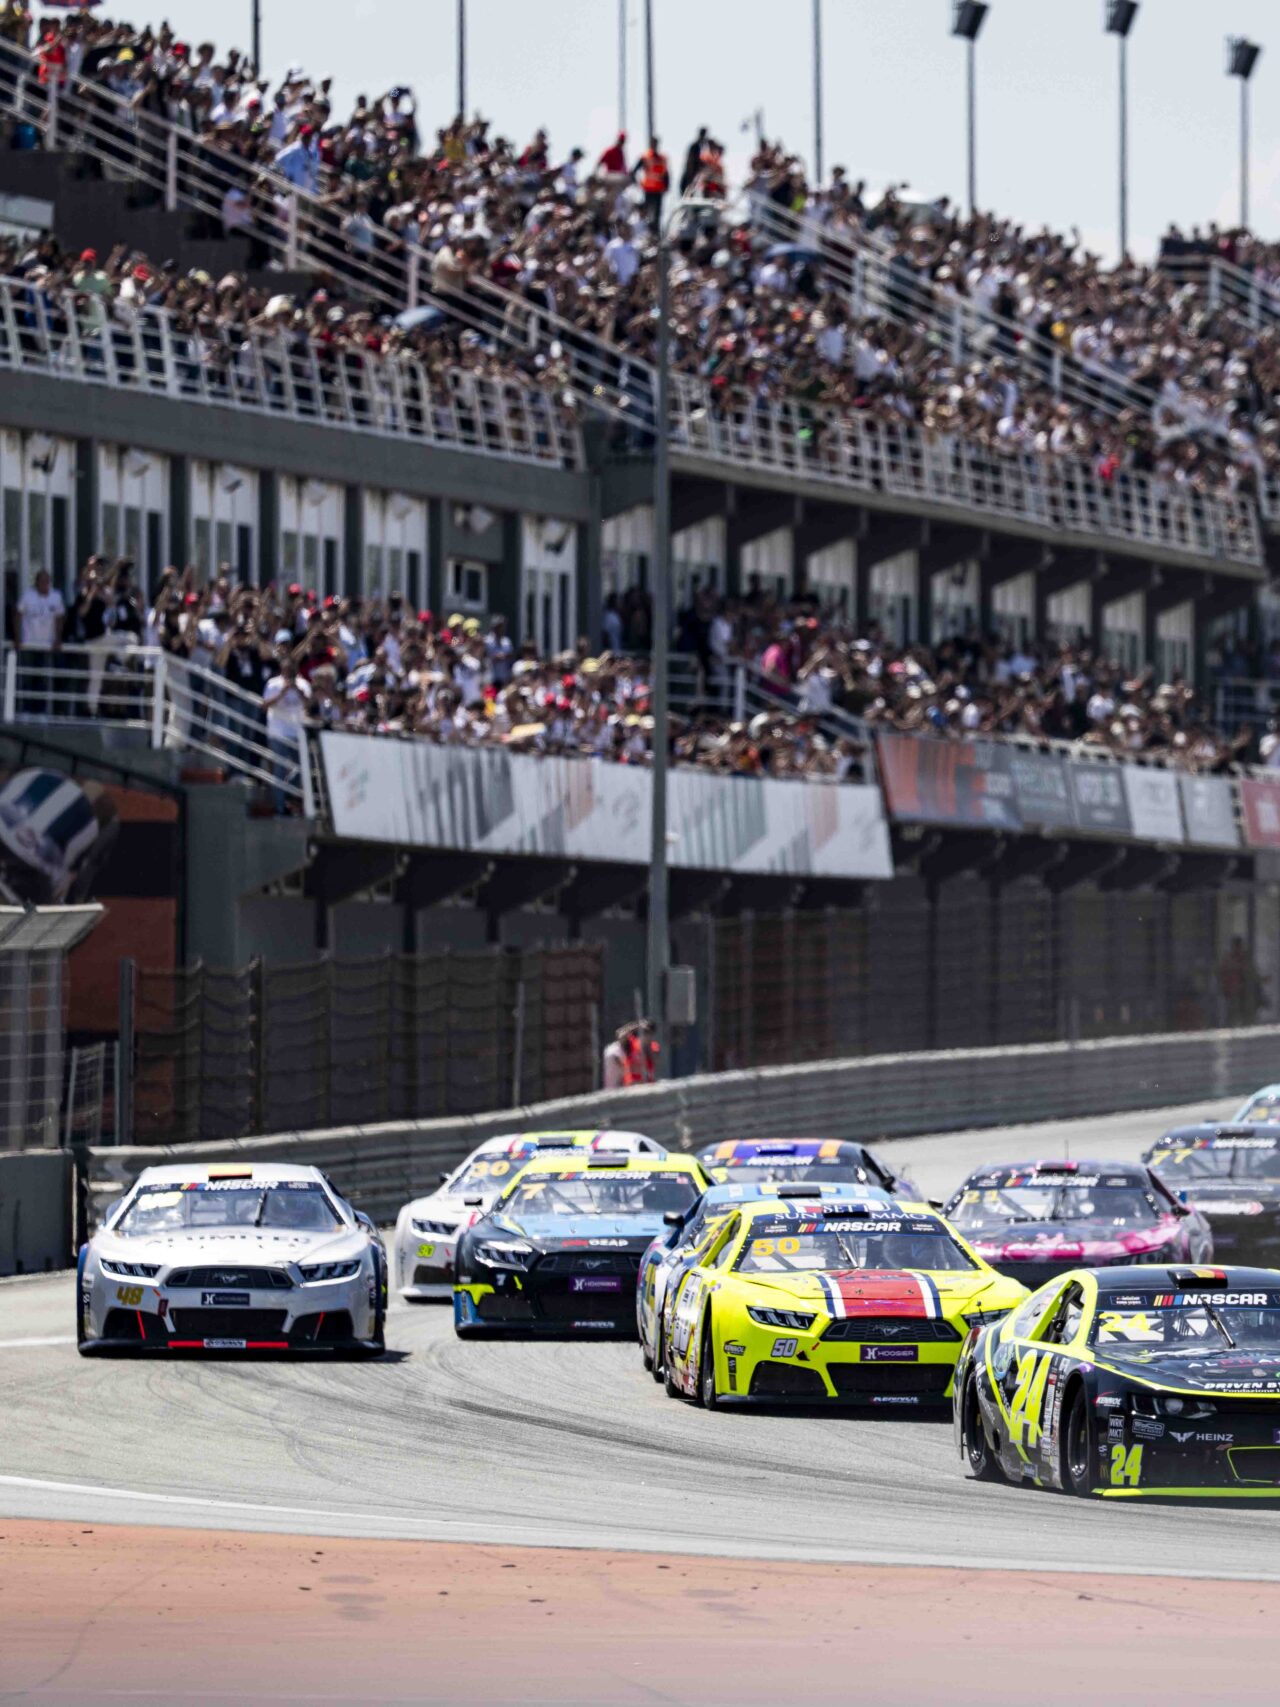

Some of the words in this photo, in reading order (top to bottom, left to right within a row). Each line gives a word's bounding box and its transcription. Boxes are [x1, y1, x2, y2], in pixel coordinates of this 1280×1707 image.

[1152, 1149, 1192, 1165] 77
[471, 1160, 510, 1177] 30
[580, 1171, 651, 1180] NASCAR
[205, 1181, 278, 1191] NASCAR
[1029, 1176, 1098, 1187] NASCAR
[521, 1182, 546, 1200] 7
[824, 1222, 901, 1232] NASCAR
[416, 1244, 435, 1258] 30
[753, 1238, 801, 1257] 50
[117, 1286, 145, 1306] 48
[1183, 1294, 1268, 1305] NASCAR
[1099, 1312, 1150, 1332] 24
[770, 1337, 799, 1358] 50
[1008, 1348, 1055, 1449] 24
[1109, 1418, 1123, 1428] WRK
[1109, 1428, 1123, 1438] MKT
[1196, 1433, 1234, 1442] HEINZ
[1111, 1444, 1144, 1485] 24
